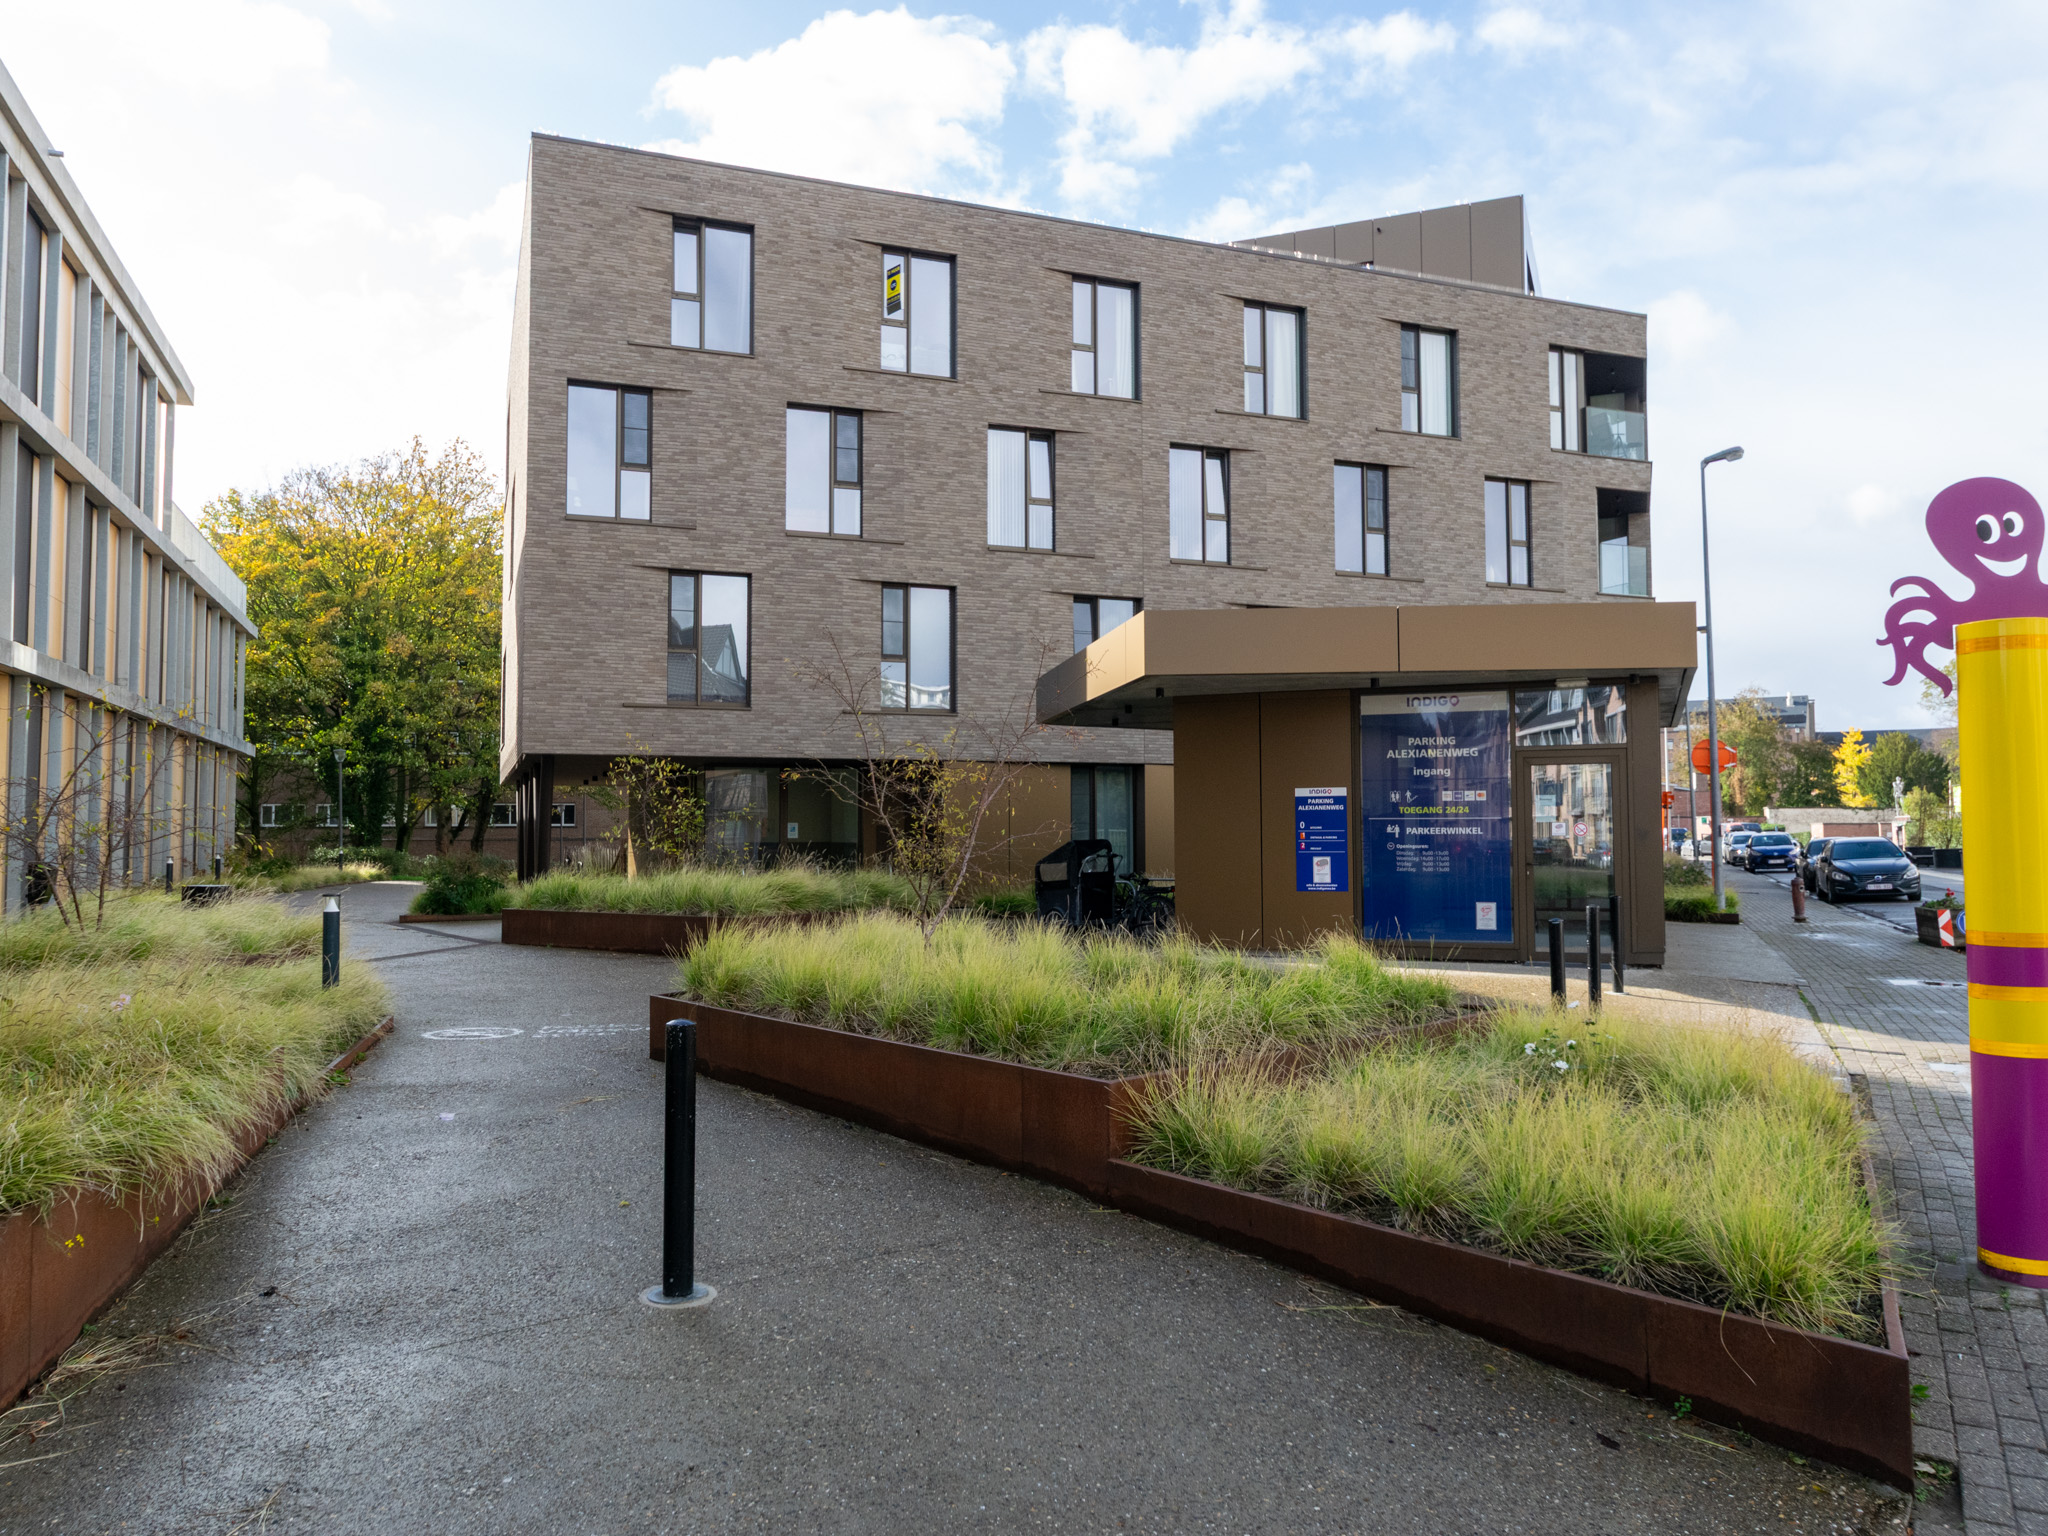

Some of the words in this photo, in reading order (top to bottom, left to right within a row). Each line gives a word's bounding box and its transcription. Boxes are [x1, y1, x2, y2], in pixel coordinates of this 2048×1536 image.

[1406, 695, 1460, 708] INDIGO
[1408, 736, 1456, 746] PARKING
[1386, 747, 1479, 759] ALEXIANENWEG
[1413, 766, 1451, 778] ingang
[1399, 806, 1443, 814] TOEGANG
[1445, 806, 1470, 814] 24/24
[1299, 821, 1305, 829] 0
[1406, 827, 1483, 835] PARKEERWINKEL
